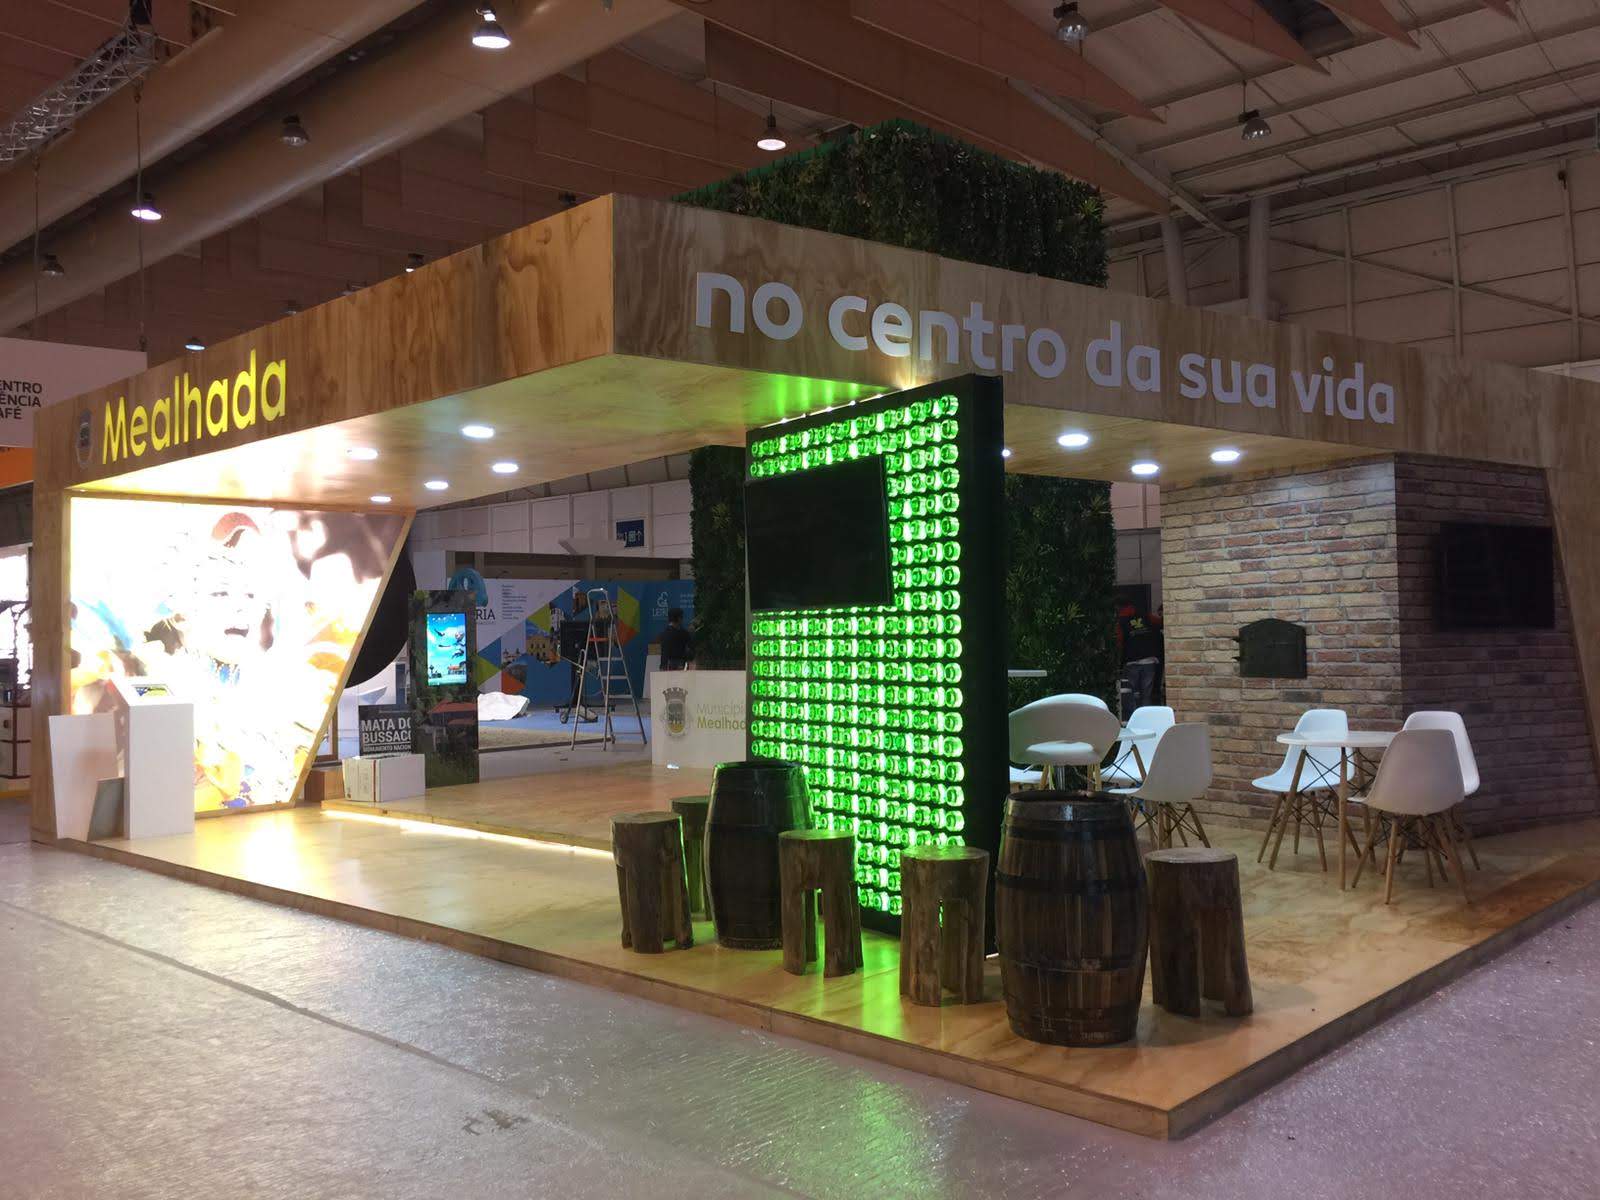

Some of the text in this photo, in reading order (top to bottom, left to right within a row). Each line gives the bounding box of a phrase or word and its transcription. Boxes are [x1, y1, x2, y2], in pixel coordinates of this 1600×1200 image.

[102, 348, 287, 465] Mealhada
[695, 271, 1395, 425] no centro da sua vida
[361, 718, 396, 732] MATA
